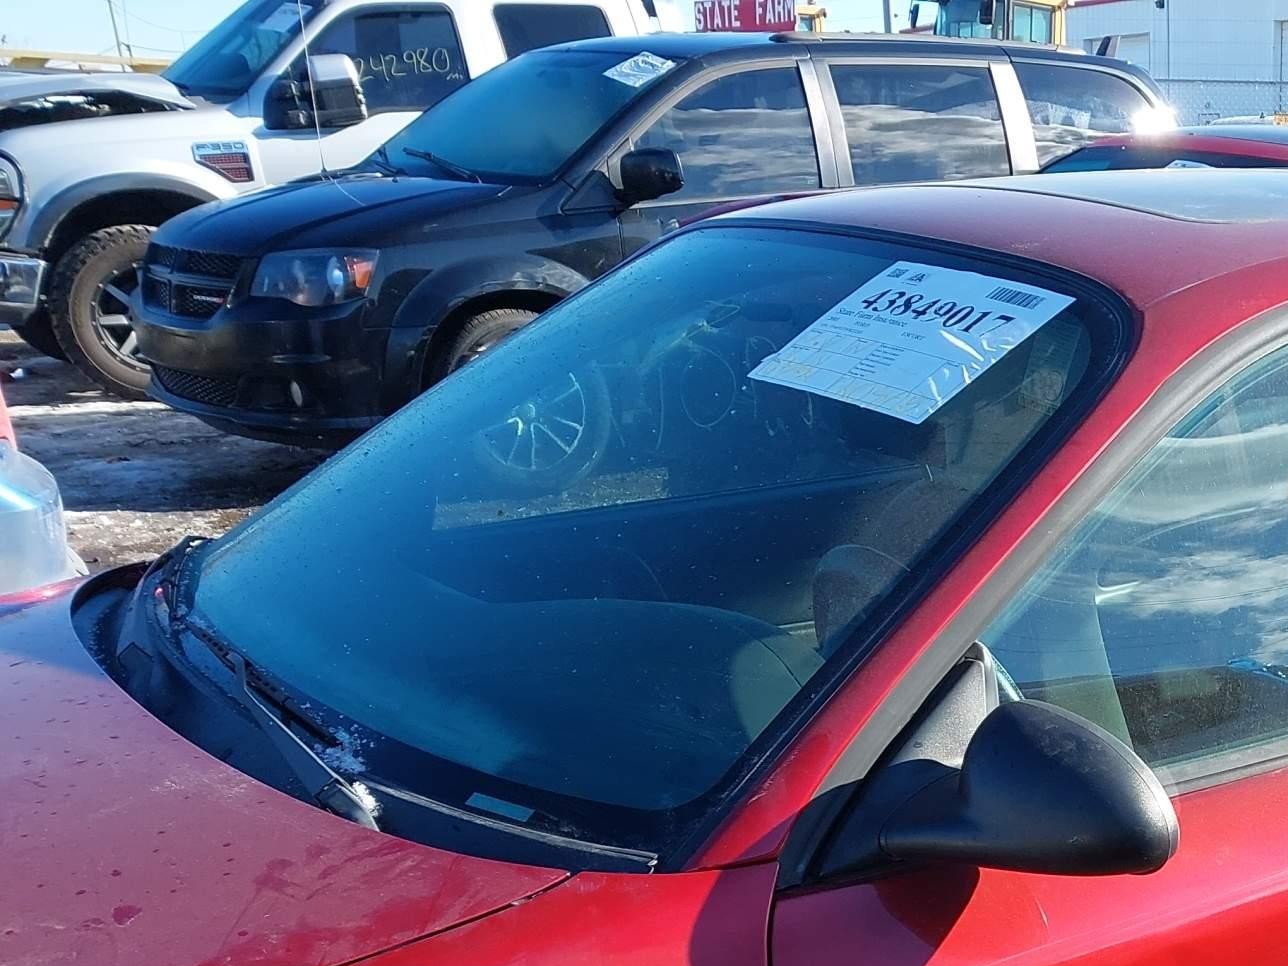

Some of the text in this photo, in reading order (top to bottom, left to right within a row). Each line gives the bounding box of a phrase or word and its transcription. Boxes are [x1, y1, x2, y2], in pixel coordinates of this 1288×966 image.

[695, 0, 795, 30] STATE FARM
[354, 47, 450, 82] 242980
[861, 288, 1017, 337] 43849017
